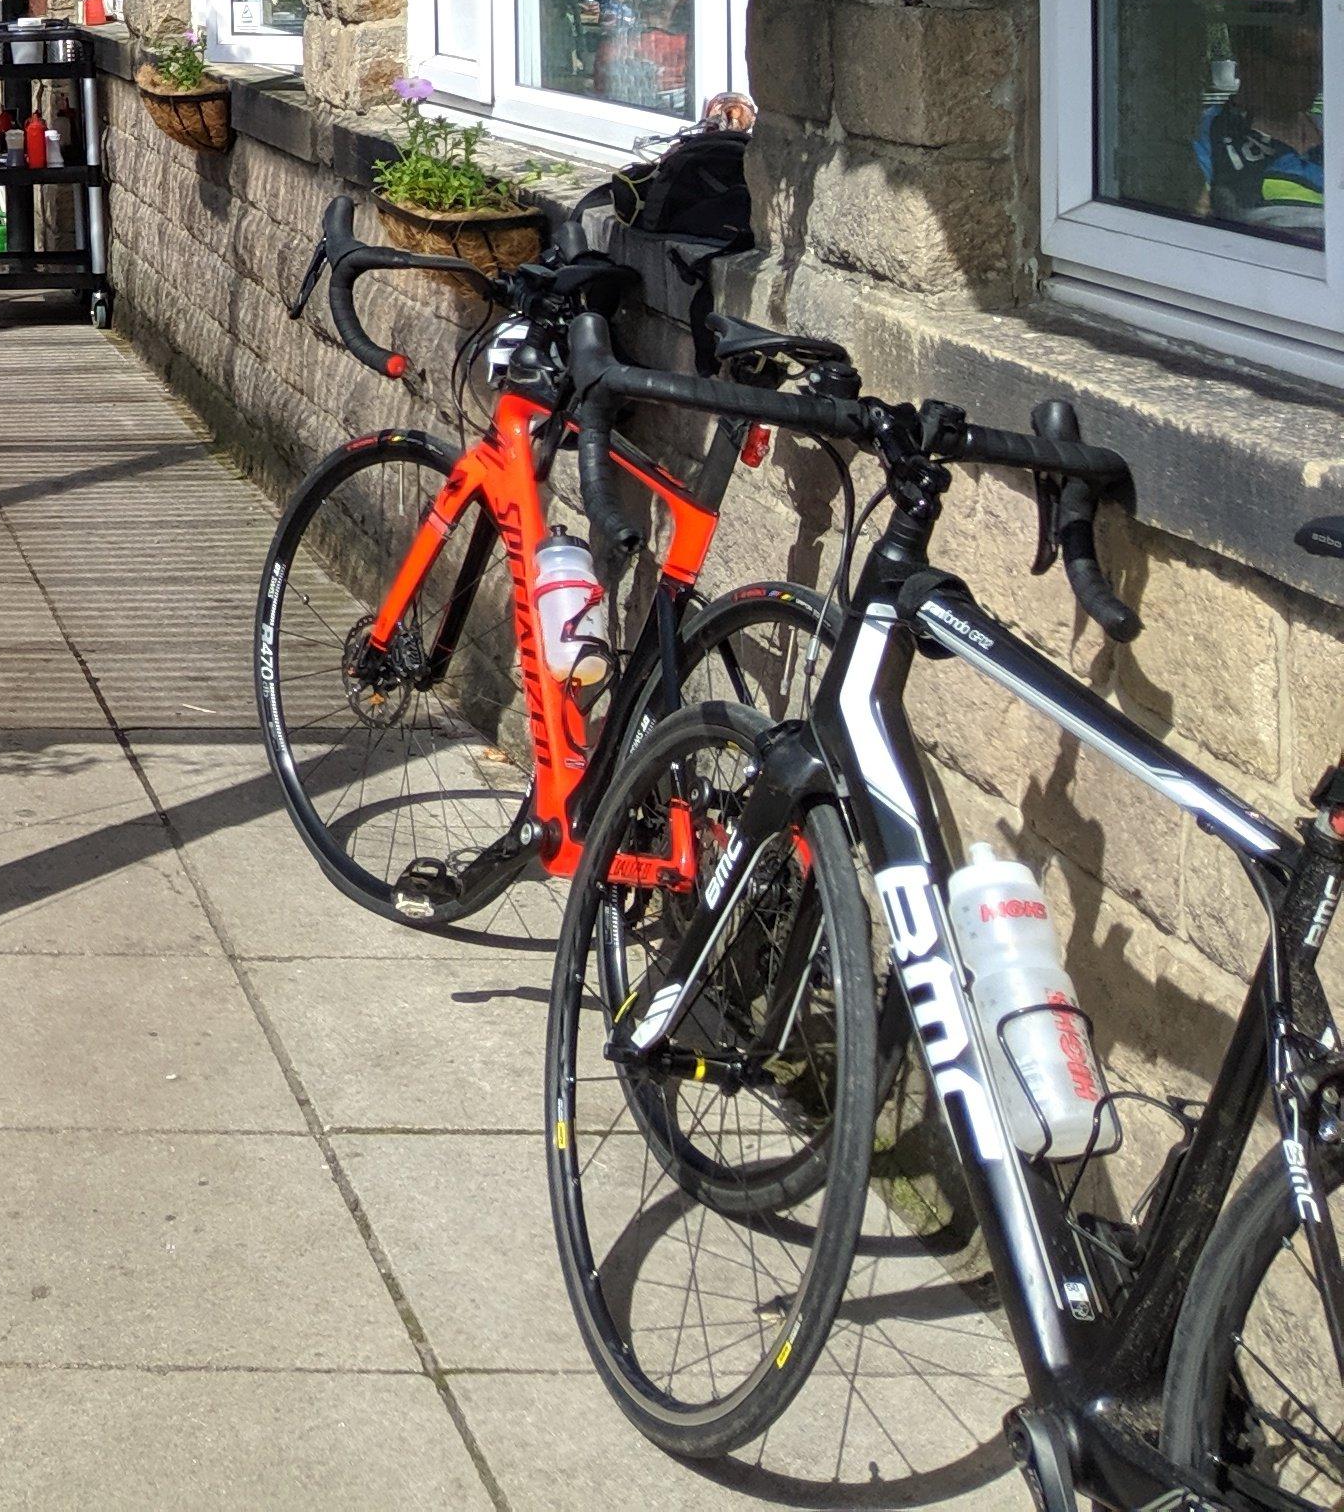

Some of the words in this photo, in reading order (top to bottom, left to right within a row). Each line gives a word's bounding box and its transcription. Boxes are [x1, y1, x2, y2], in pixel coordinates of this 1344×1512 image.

[260, 622, 274, 680] R470
[705, 828, 743, 910] BMC
[1303, 874, 1338, 948] BMC
[874, 865, 1004, 1160] BMC
[1282, 1139, 1322, 1223] BMC
